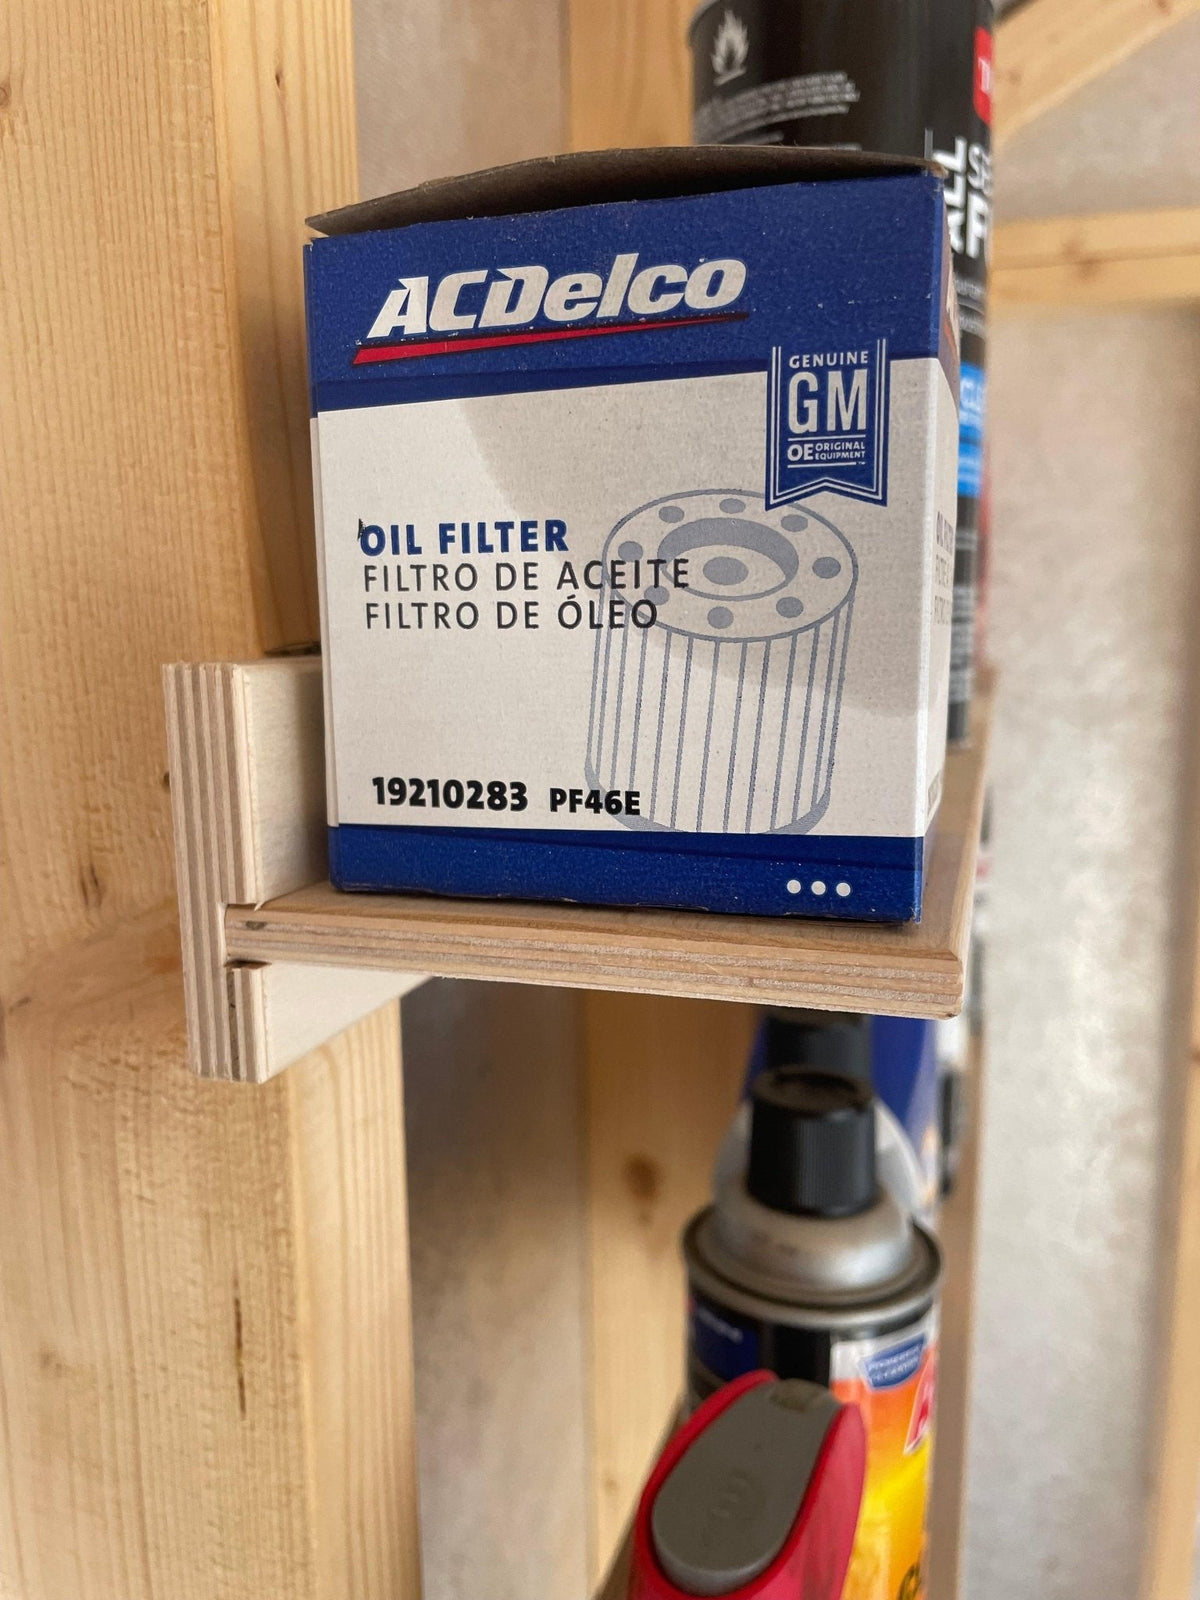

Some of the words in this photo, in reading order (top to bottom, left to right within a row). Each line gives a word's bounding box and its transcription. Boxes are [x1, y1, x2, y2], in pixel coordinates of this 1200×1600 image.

[366, 253, 747, 339] ACDelco
[788, 350, 869, 369] GENUINE
[788, 368, 868, 434] GM
[787, 443, 814, 462] OE
[815, 441, 865, 451] ORIGINAL
[815, 450, 866, 461] EQUIPMENT
[359, 523, 423, 557] OIL
[439, 519, 569, 555] FILTER
[363, 562, 478, 592] FILTRO
[495, 561, 540, 591] DE
[556, 558, 690, 590] ACEITE
[366, 601, 480, 630] FILTRO
[496, 601, 540, 630] DE
[557, 594, 658, 630] ÓLEO
[372, 776, 529, 812] 19210283
[549, 787, 641, 816] PF46E
